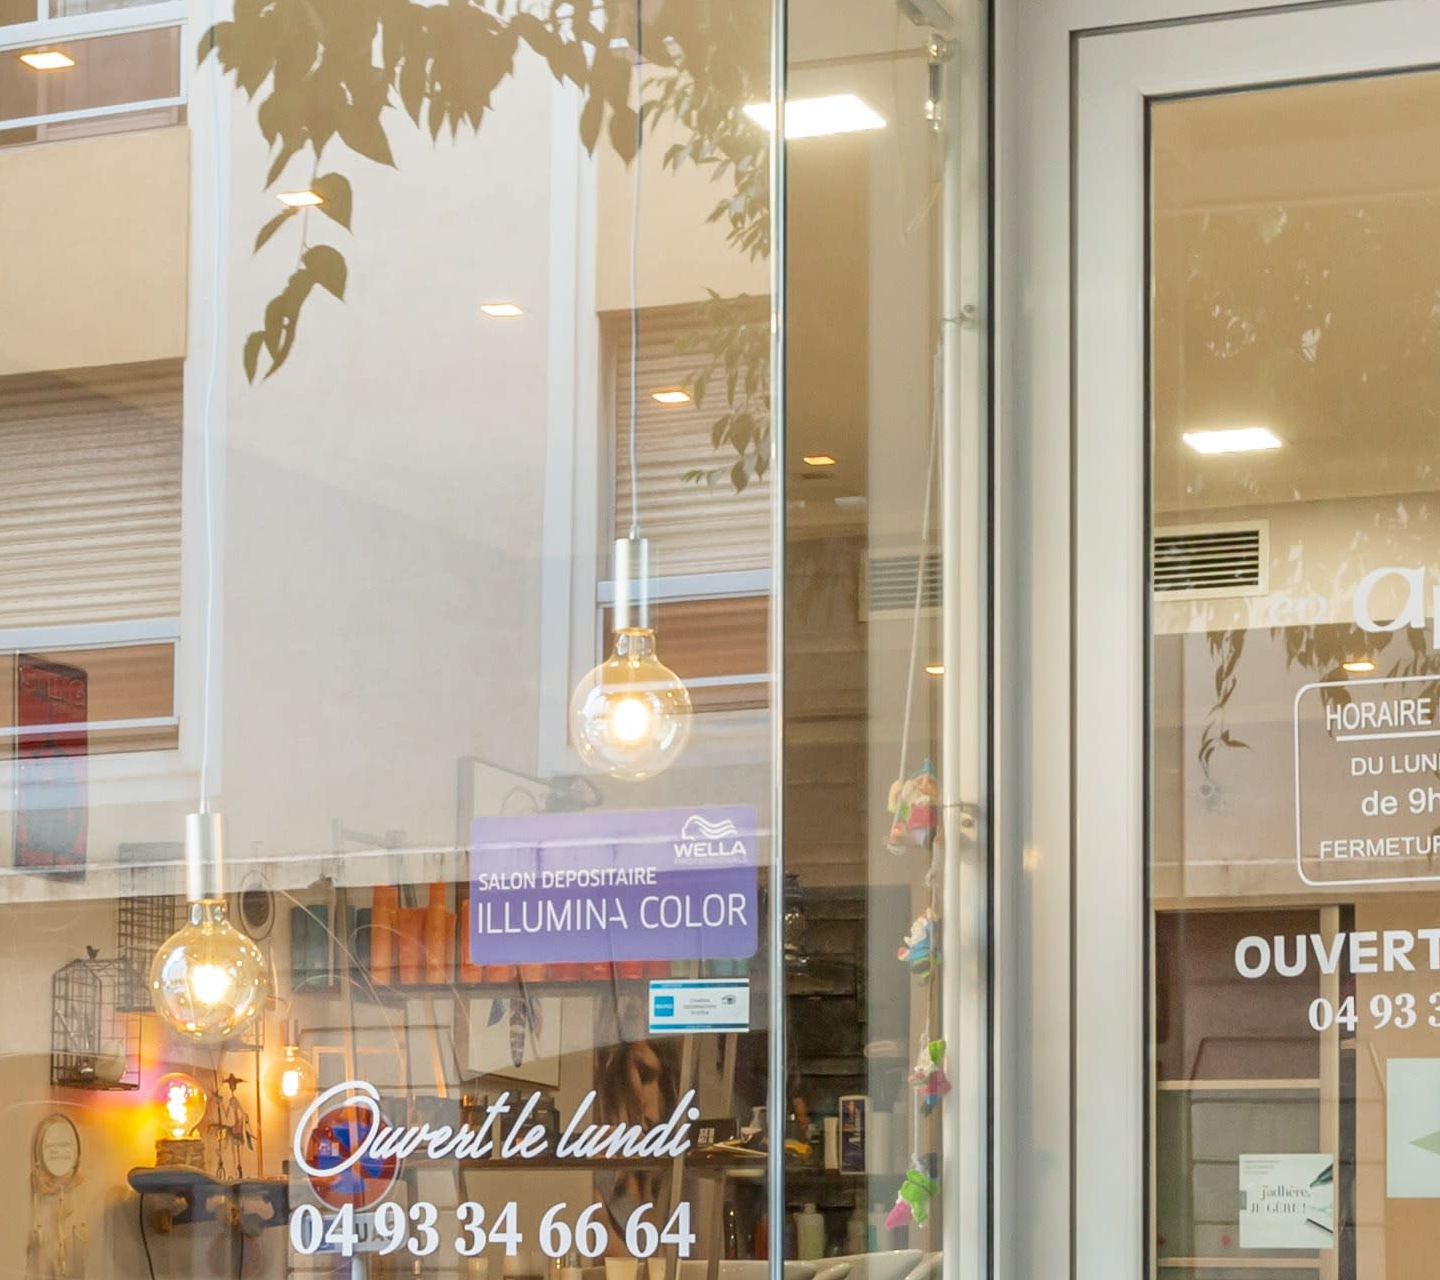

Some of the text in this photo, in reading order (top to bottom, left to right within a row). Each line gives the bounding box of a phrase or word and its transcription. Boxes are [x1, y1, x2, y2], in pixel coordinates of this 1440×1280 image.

[1326, 698, 1431, 731] HORAIRE
[1351, 756, 1384, 777] DU
[1361, 790, 1398, 817] de
[674, 840, 747, 858] WELLA
[478, 866, 658, 892] SALON DEPOSITAIRE
[477, 892, 748, 935] ILLUMINA COLOR
[1308, 996, 1358, 1032] 04
[1369, 992, 1417, 1030] 93
[292, 1079, 701, 1177] Ouvert le lundi
[289, 1202, 359, 1257] 04
[372, 1201, 440, 1256] 93
[454, 1201, 523, 1256] 34
[538, 1201, 608, 1258] 66
[624, 1201, 696, 1258] 64
